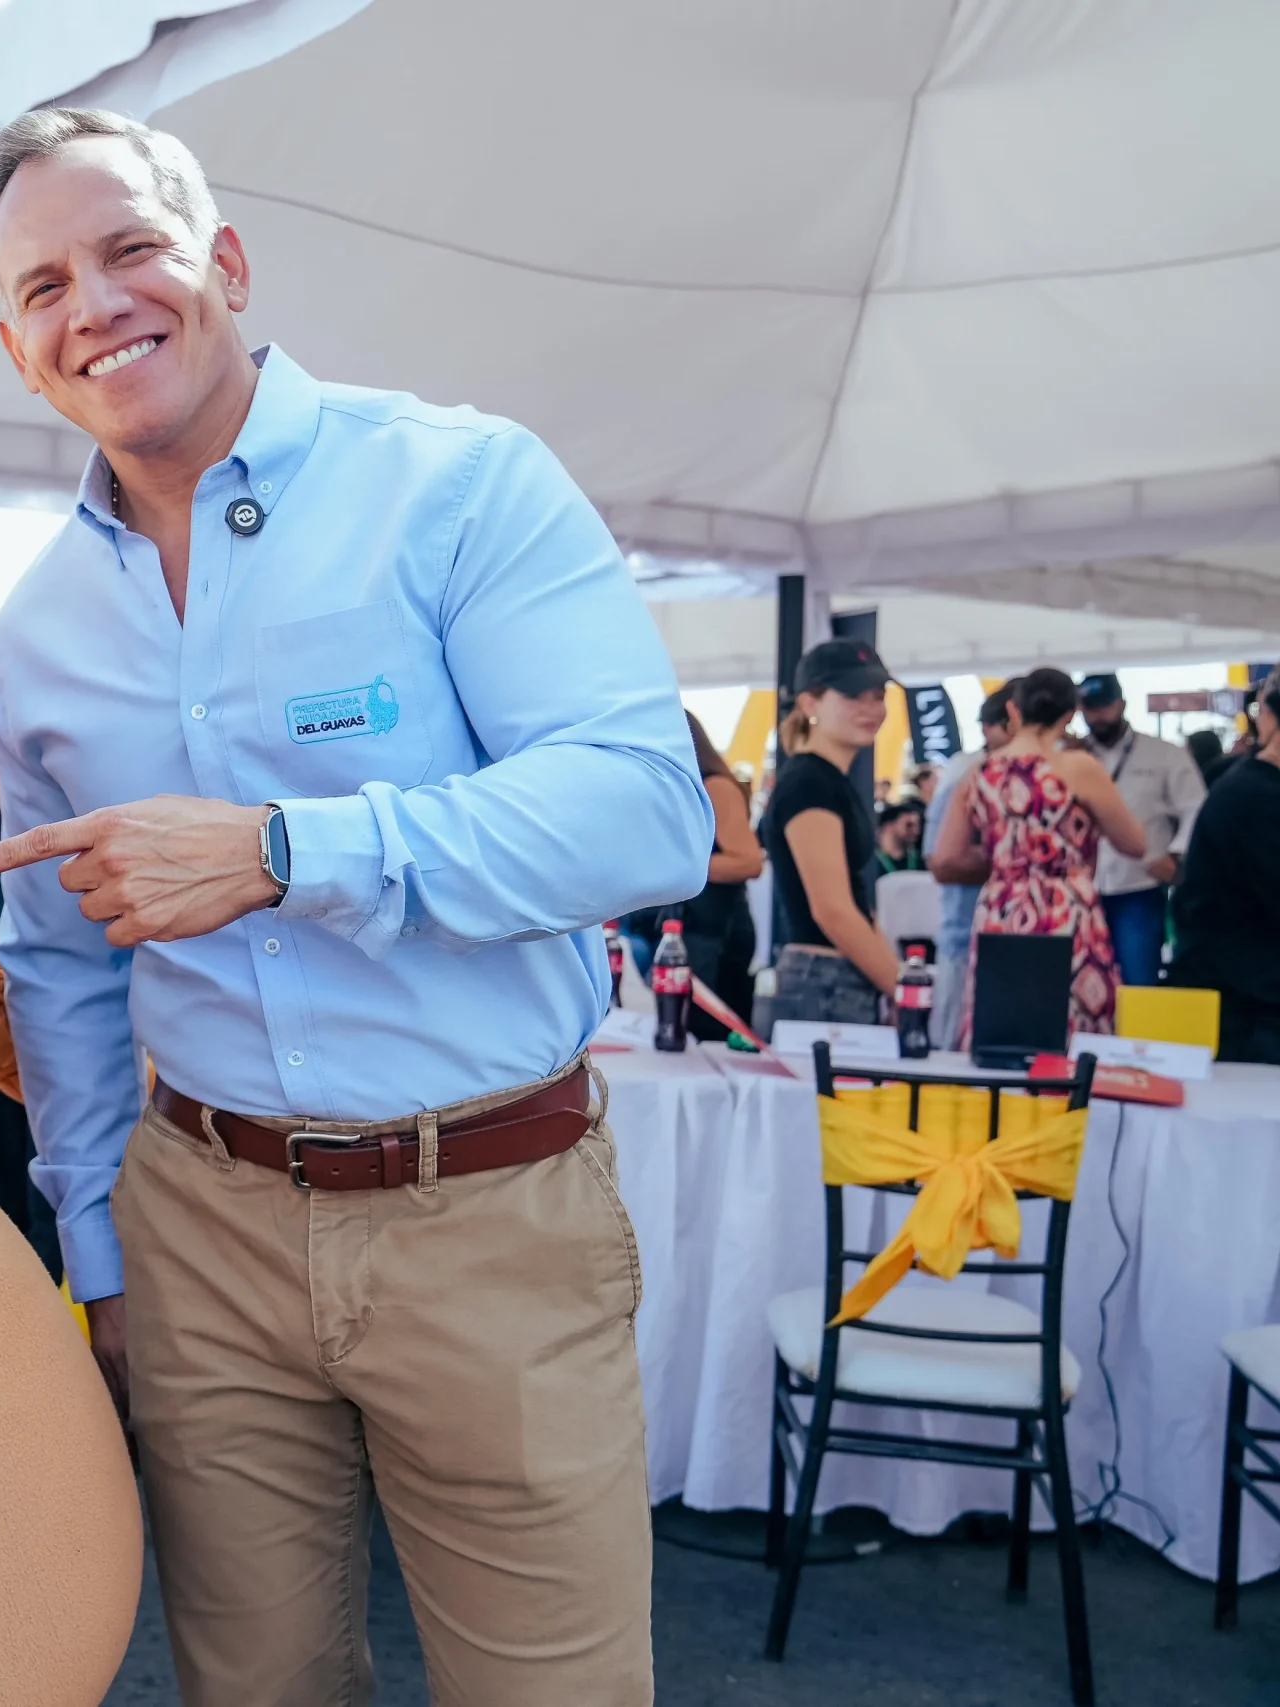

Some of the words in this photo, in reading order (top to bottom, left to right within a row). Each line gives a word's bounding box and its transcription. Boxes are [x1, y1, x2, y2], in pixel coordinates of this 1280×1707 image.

[292, 696, 361, 714] PREFECTURA
[295, 707, 362, 725] CIUDADANA
[297, 724, 320, 735] DEL
[320, 716, 366, 731] GUAYAS
